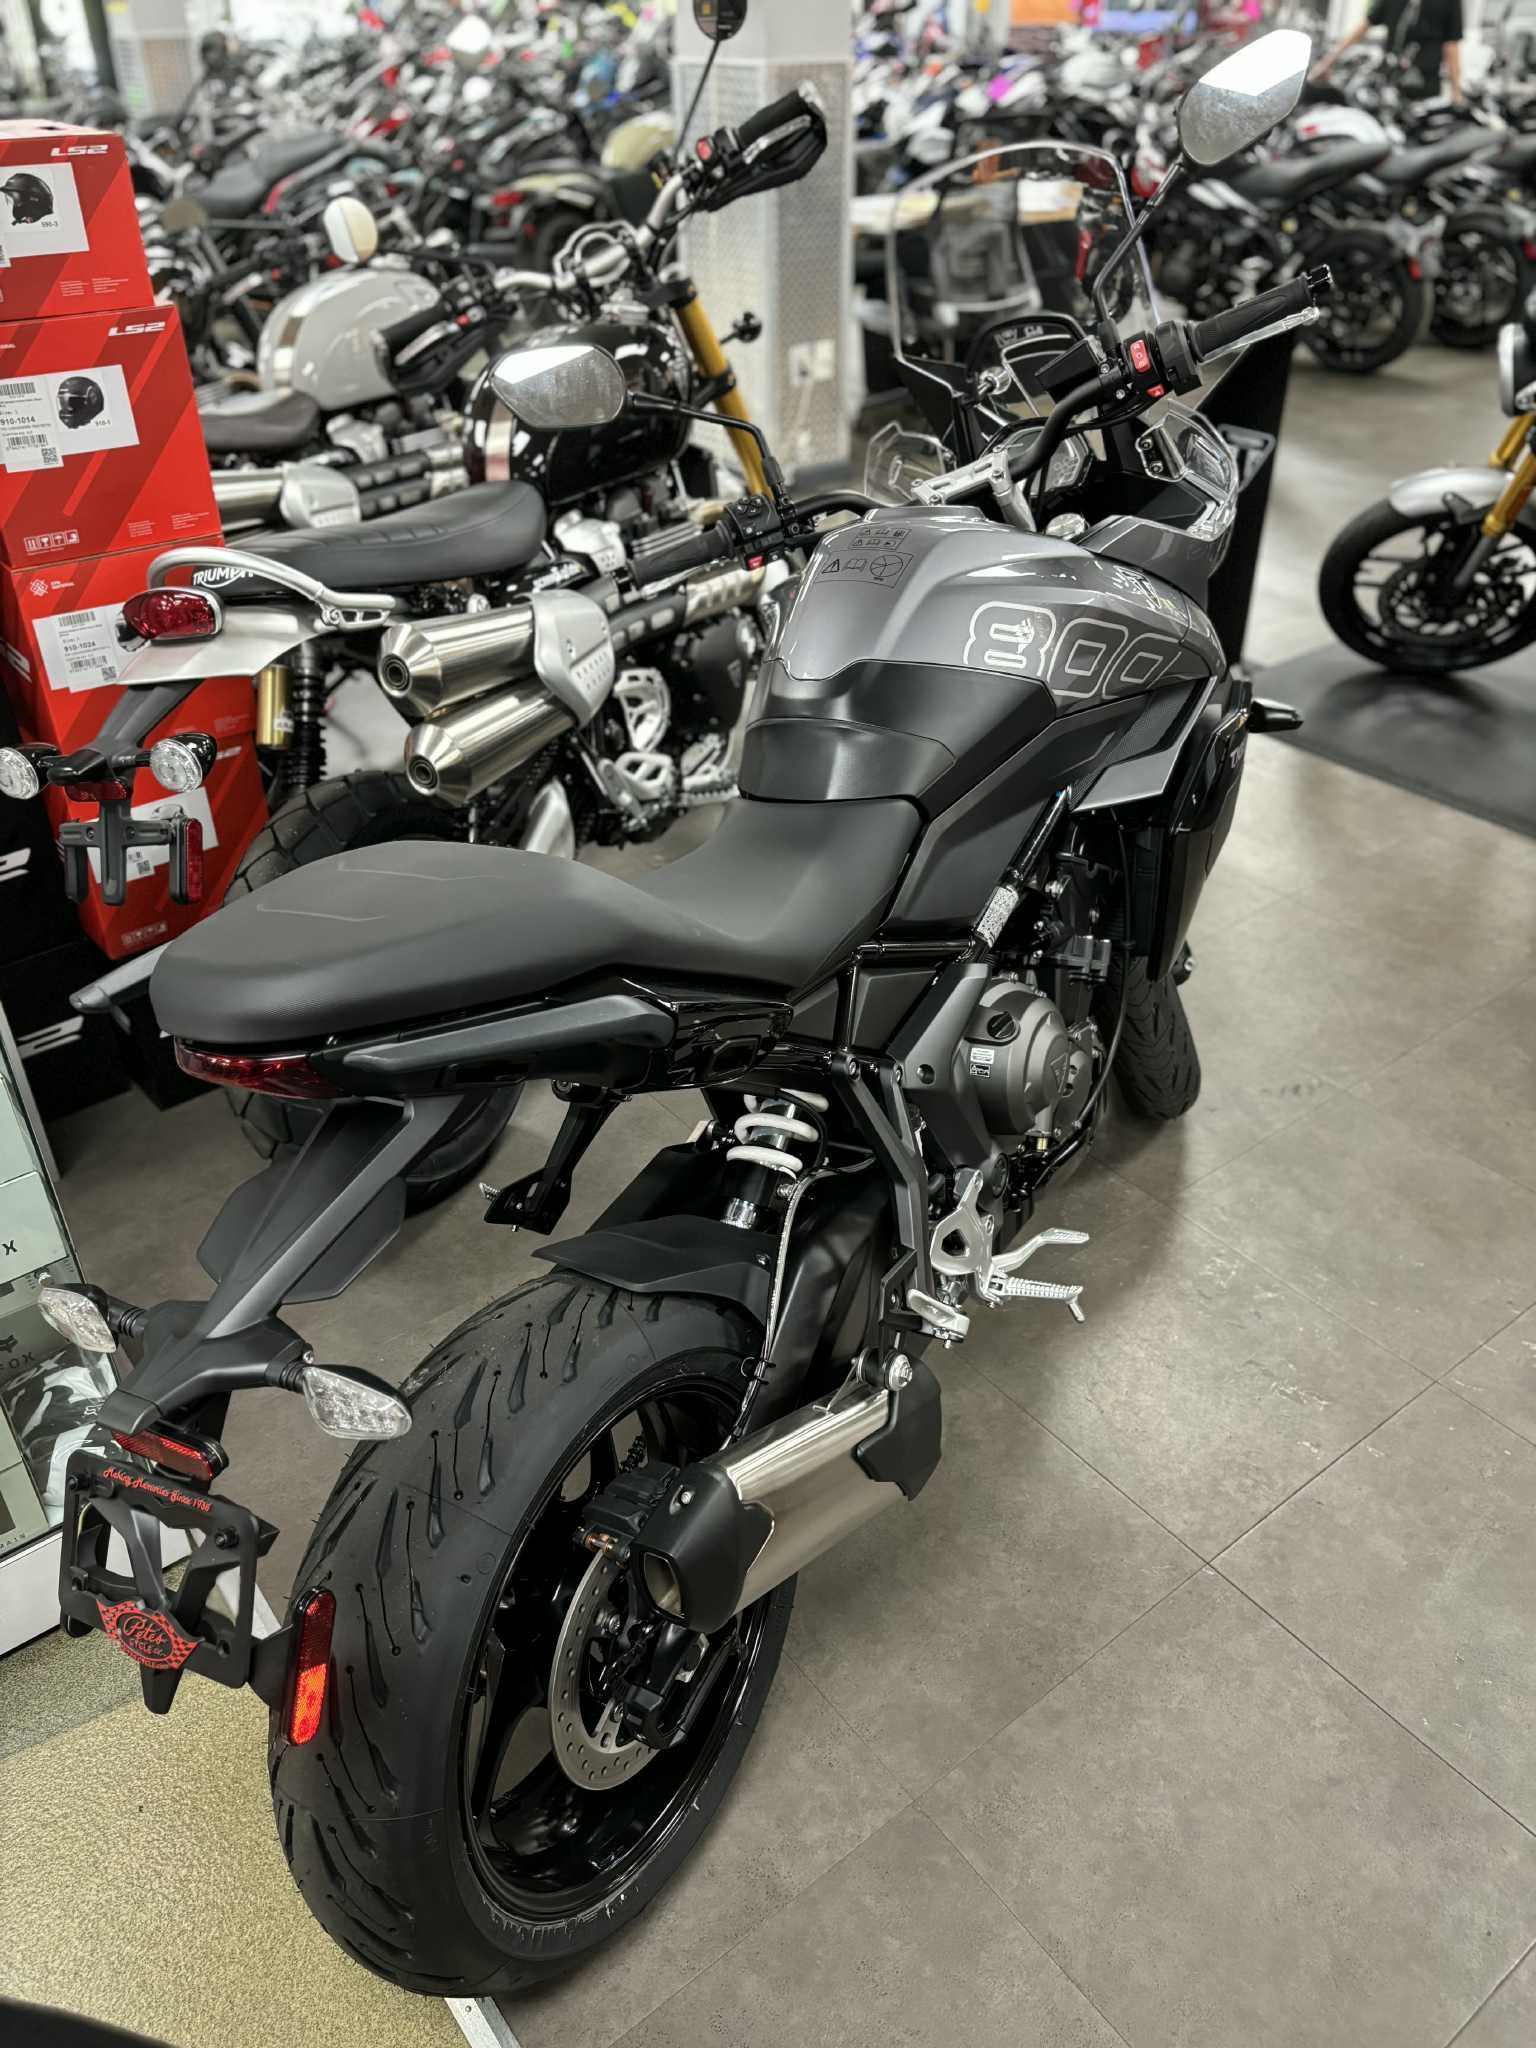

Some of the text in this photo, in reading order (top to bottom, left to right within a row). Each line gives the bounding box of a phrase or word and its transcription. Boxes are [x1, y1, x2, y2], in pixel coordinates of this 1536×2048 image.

[50, 144, 109, 157] LS2
[108, 321, 166, 337] LS2
[963, 600, 1182, 699] 800
[103, 1466, 132, 1488] Making
[132, 1477, 169, 1497] Memories
[169, 1489, 193, 1505] Since
